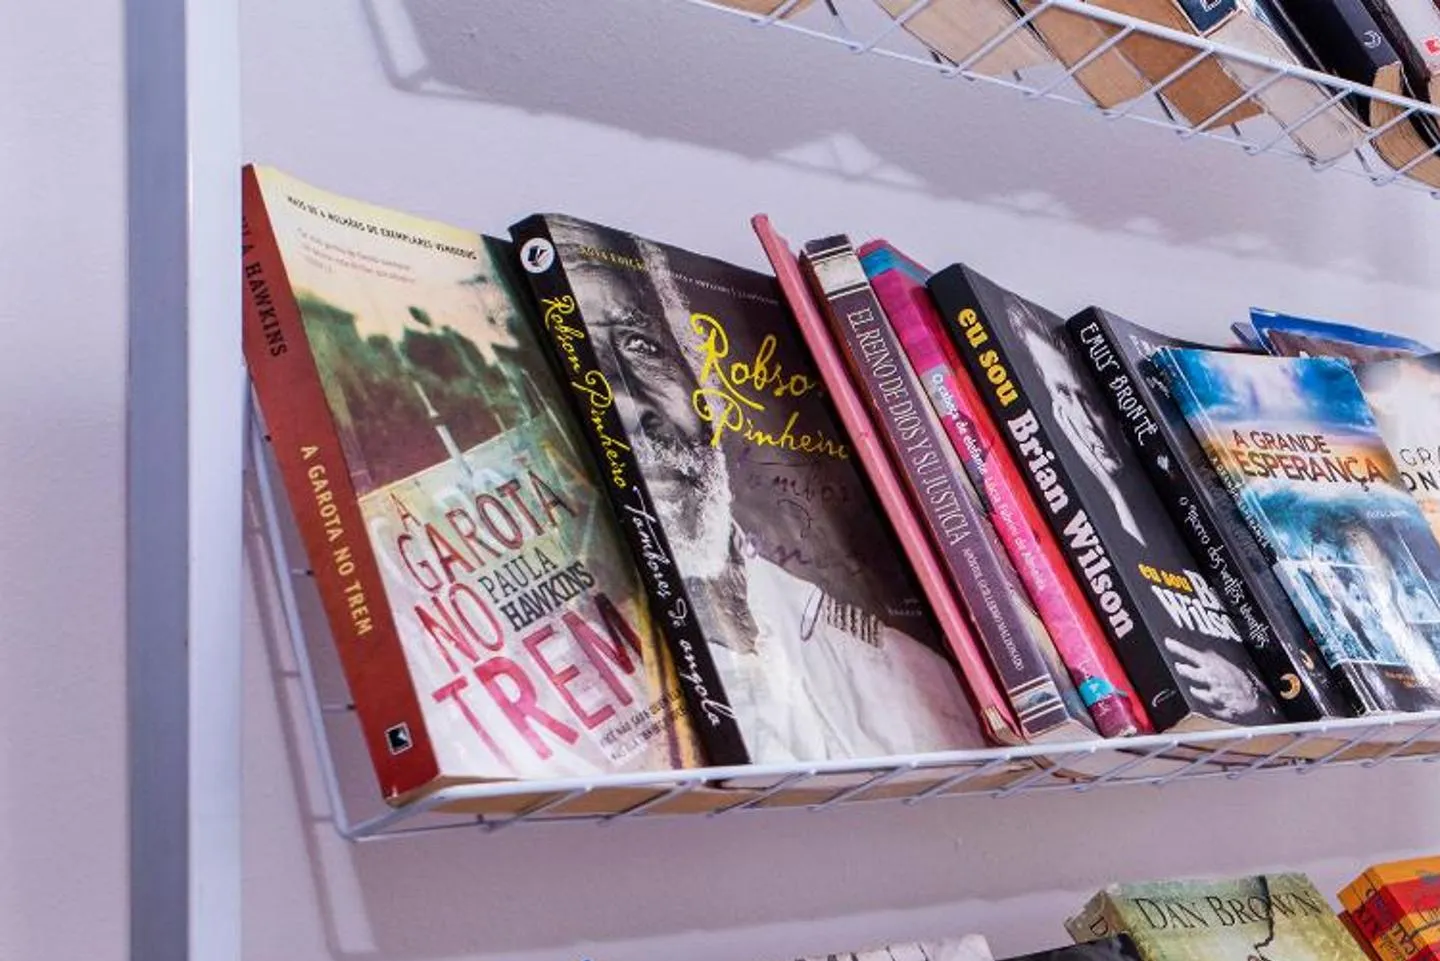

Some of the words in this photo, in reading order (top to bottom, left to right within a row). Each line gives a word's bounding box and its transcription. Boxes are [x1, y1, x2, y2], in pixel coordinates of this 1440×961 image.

[245, 261, 288, 358] HAWKINS
[847, 307, 875, 331] EL
[689, 312, 816, 413] Robso
[856, 328, 899, 383] REINO
[879, 374, 910, 404] DE
[1078, 321, 1121, 373] EMILY
[1107, 372, 1159, 447] BRONTË
[541, 294, 584, 374] Robson
[571, 369, 631, 491] Pinheiro
[624, 485, 671, 598] Tambores
[889, 397, 923, 442] DIOS
[906, 435, 932, 454] Y
[1233, 430, 1248, 449] A
[1250, 430, 1332, 454] GRANDE
[301, 445, 319, 460] A
[912, 446, 940, 475] SU
[957, 307, 989, 349] eu
[978, 349, 1020, 408] sou
[1006, 408, 1069, 515] Brian
[1063, 509, 1135, 640] Wilson
[1239, 452, 1388, 492] ESPERANÇA
[308, 464, 344, 542] GAROTA
[389, 491, 421, 532] A
[922, 470, 972, 546] JUSTICIA
[397, 470, 581, 593] GAROTA
[333, 547, 354, 577] NO
[477, 546, 559, 603] PAULA
[343, 581, 373, 636] TREM
[500, 560, 596, 632] HAWKINS
[414, 582, 505, 674] NO
[431, 591, 643, 774] TREM
[1132, 897, 1208, 932] DAN
[1206, 889, 1322, 928] BROWN
